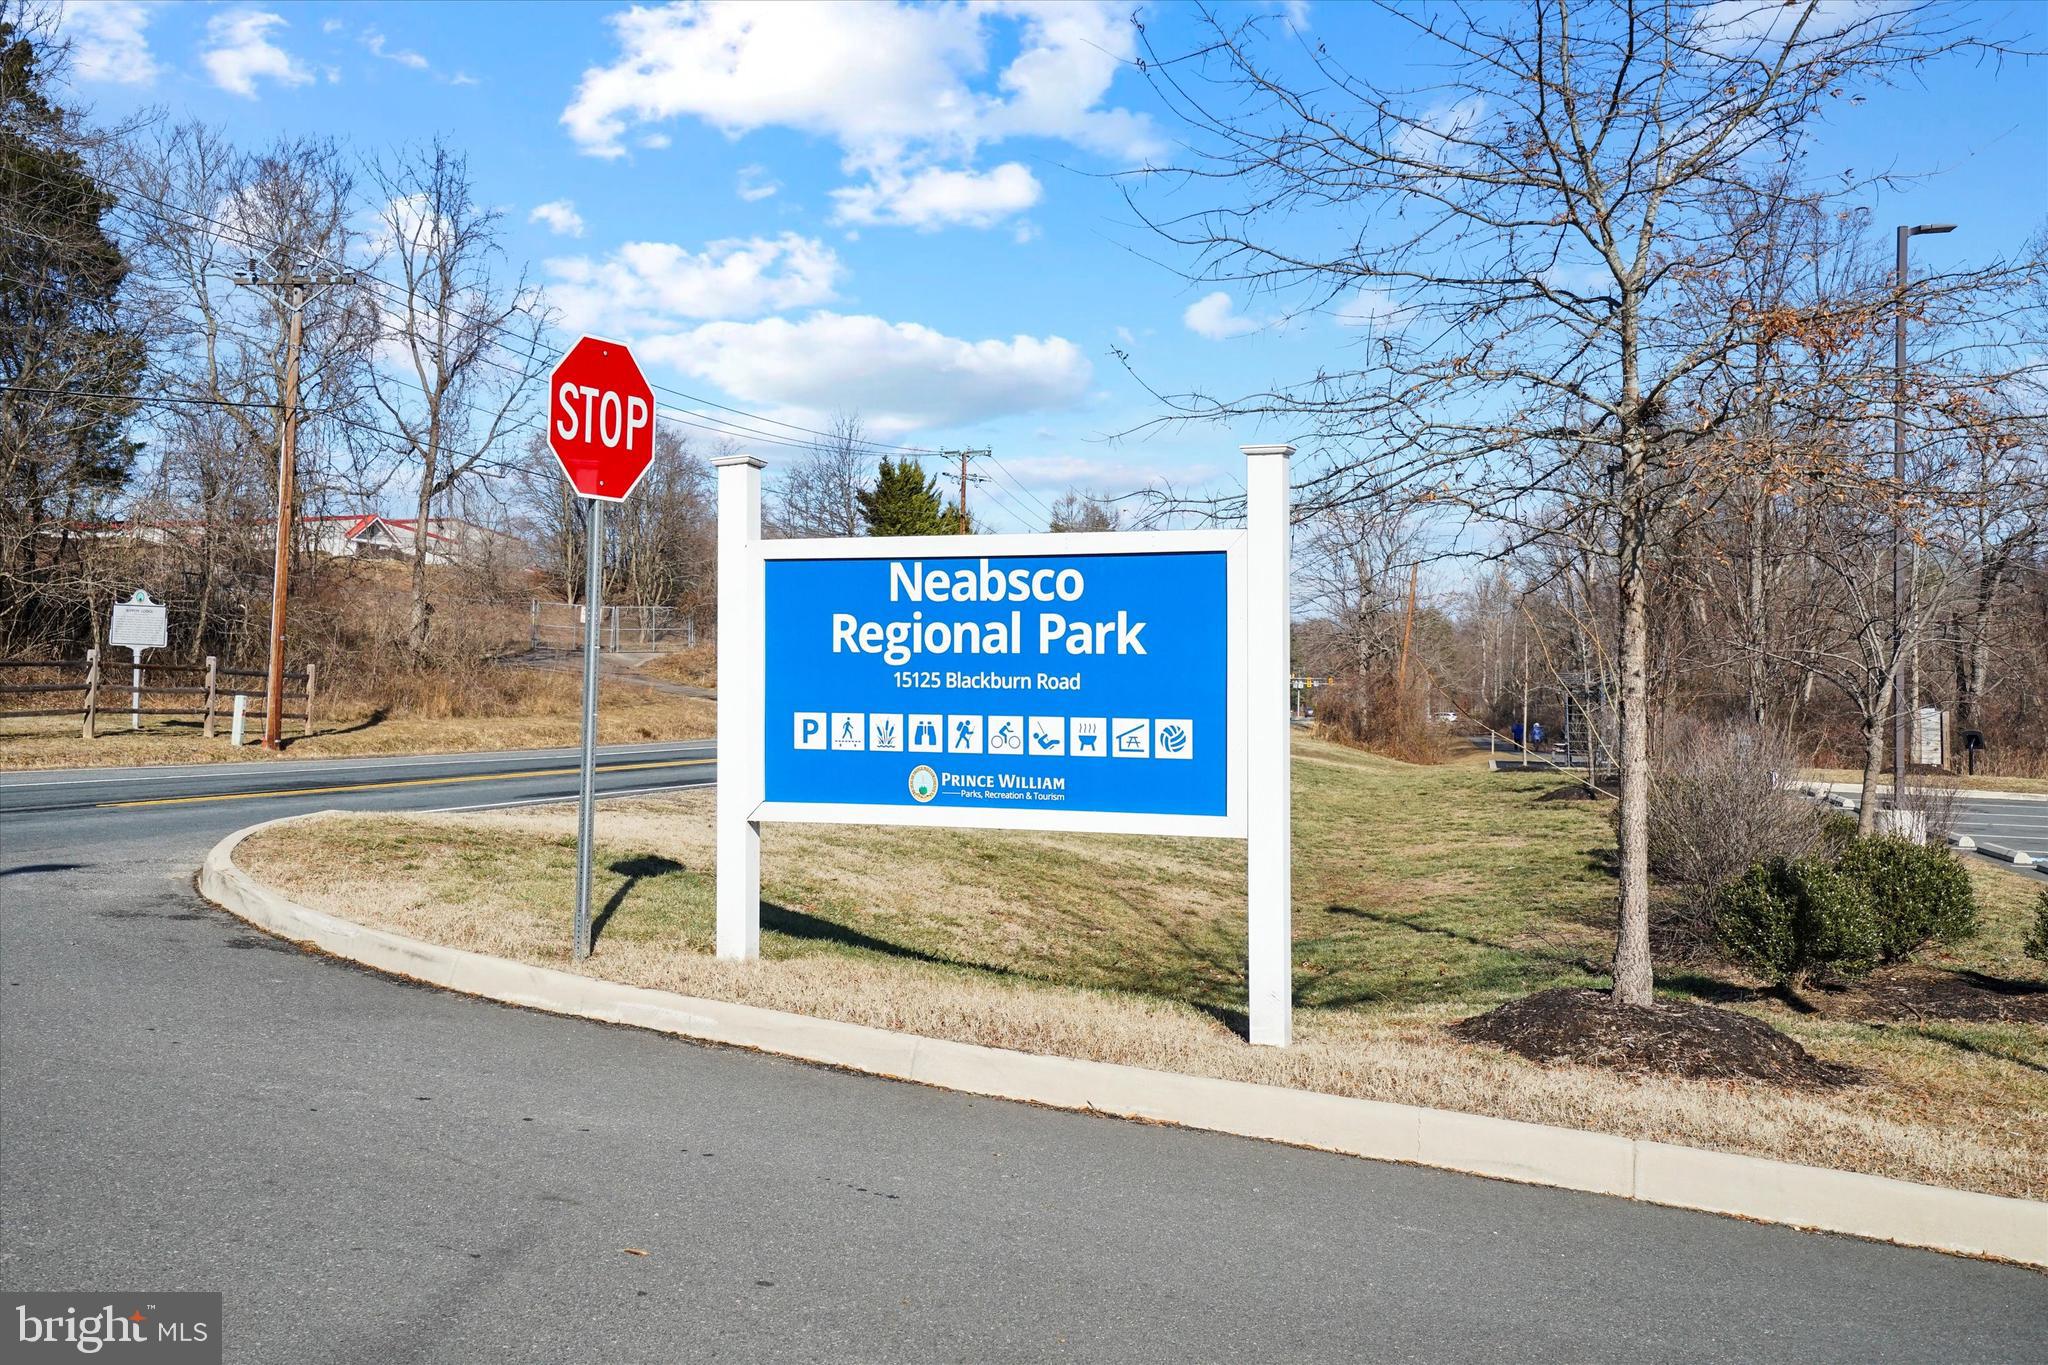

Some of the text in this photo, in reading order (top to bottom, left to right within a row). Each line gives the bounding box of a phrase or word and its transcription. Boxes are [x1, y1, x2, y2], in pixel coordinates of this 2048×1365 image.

[557, 382, 648, 450] STOP
[889, 559, 1084, 602] Neabsco
[832, 611, 1147, 666] Regional Park
[893, 672, 1081, 690] 15125 Blackburn Road
[803, 719, 819, 743] P
[941, 772, 994, 788] PRINCE
[998, 774, 1065, 789] WILLIAM
[960, 790, 983, 799] Parks,
[985, 791, 1024, 800] Recreation
[1034, 792, 1065, 801] Tourism
